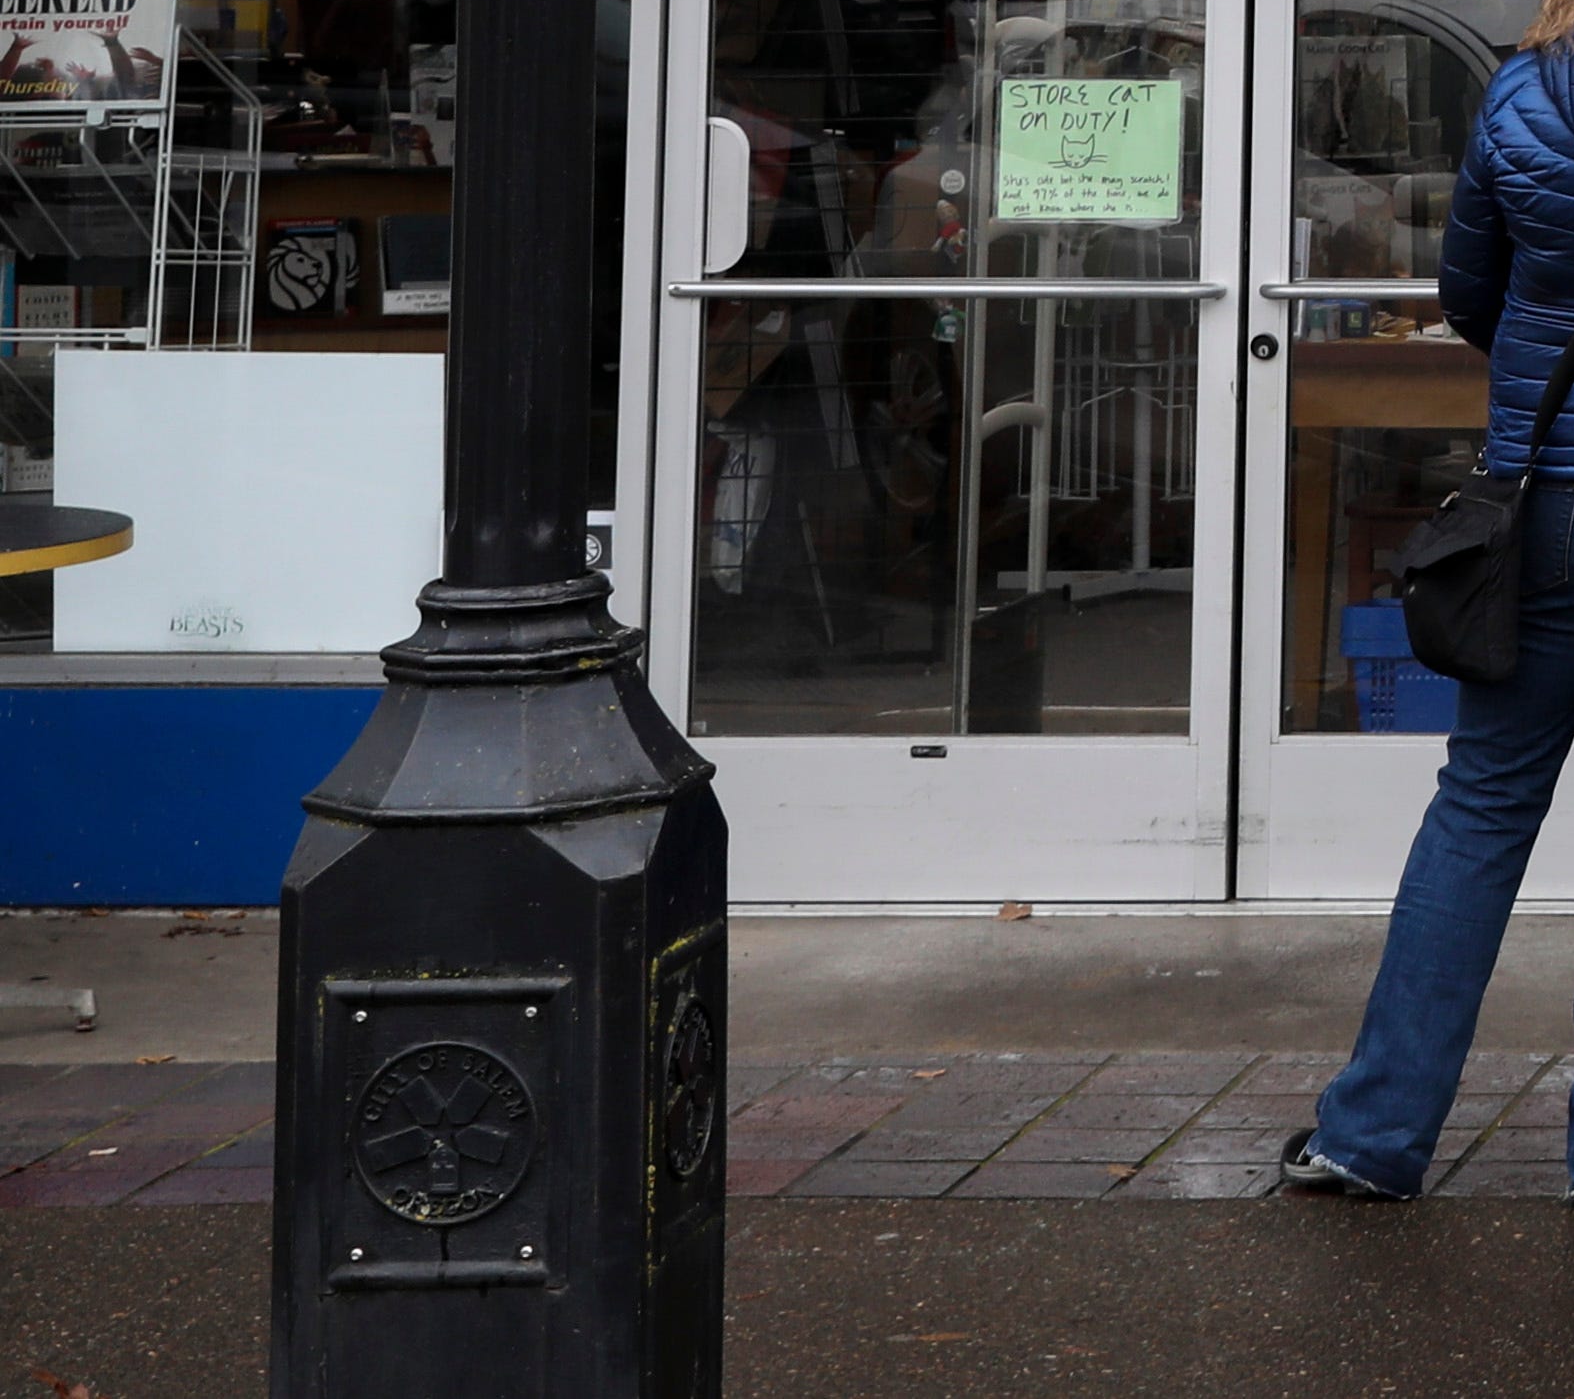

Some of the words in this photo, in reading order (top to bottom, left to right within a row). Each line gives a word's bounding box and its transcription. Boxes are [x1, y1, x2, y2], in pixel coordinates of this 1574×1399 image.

[0, 79, 79, 96] Thursday
[1010, 85, 1089, 108] STORE
[1061, 108, 1130, 133] DUTY!
